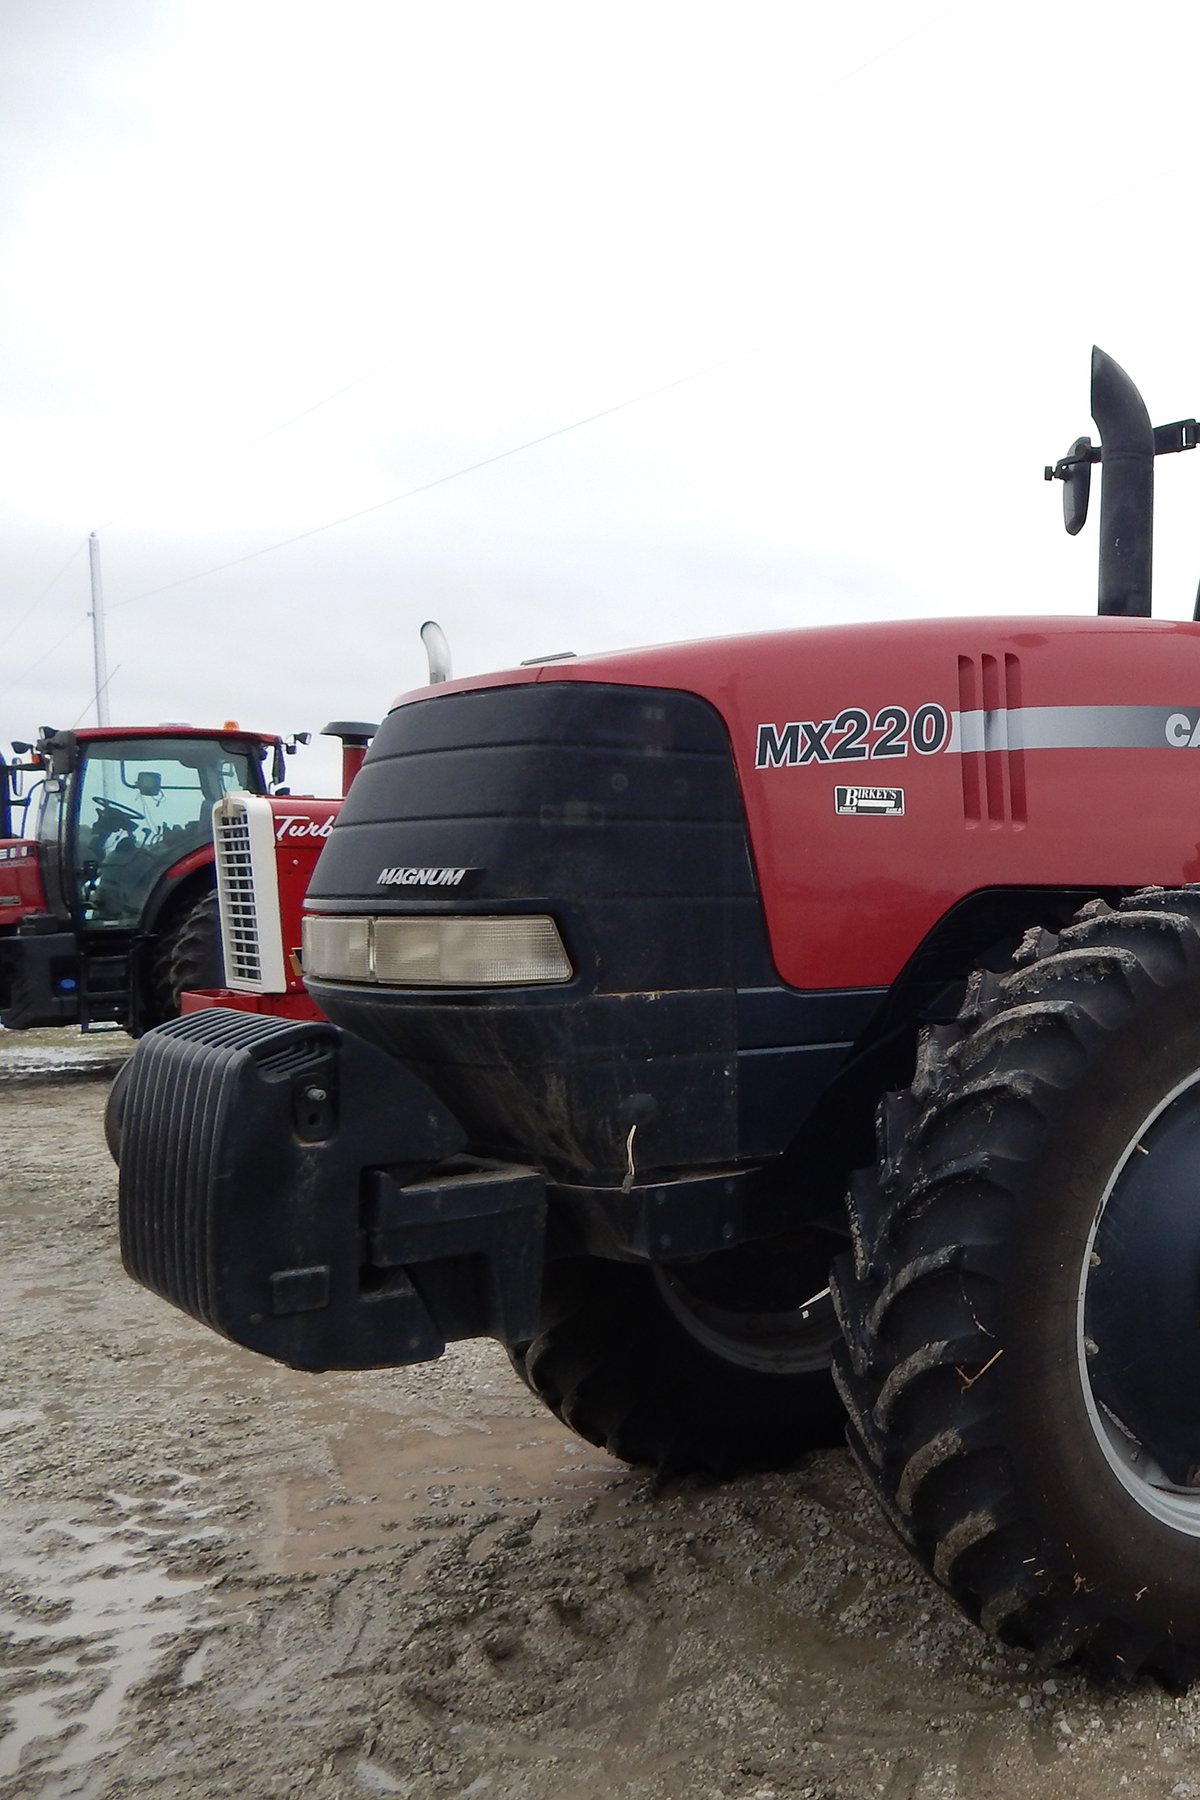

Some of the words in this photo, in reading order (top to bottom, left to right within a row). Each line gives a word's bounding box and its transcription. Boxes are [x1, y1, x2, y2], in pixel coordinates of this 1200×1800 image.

[755, 703, 947, 769] MX220
[844, 788, 897, 806] BIRKEY'S
[376, 868, 466, 885] MAGNUM
